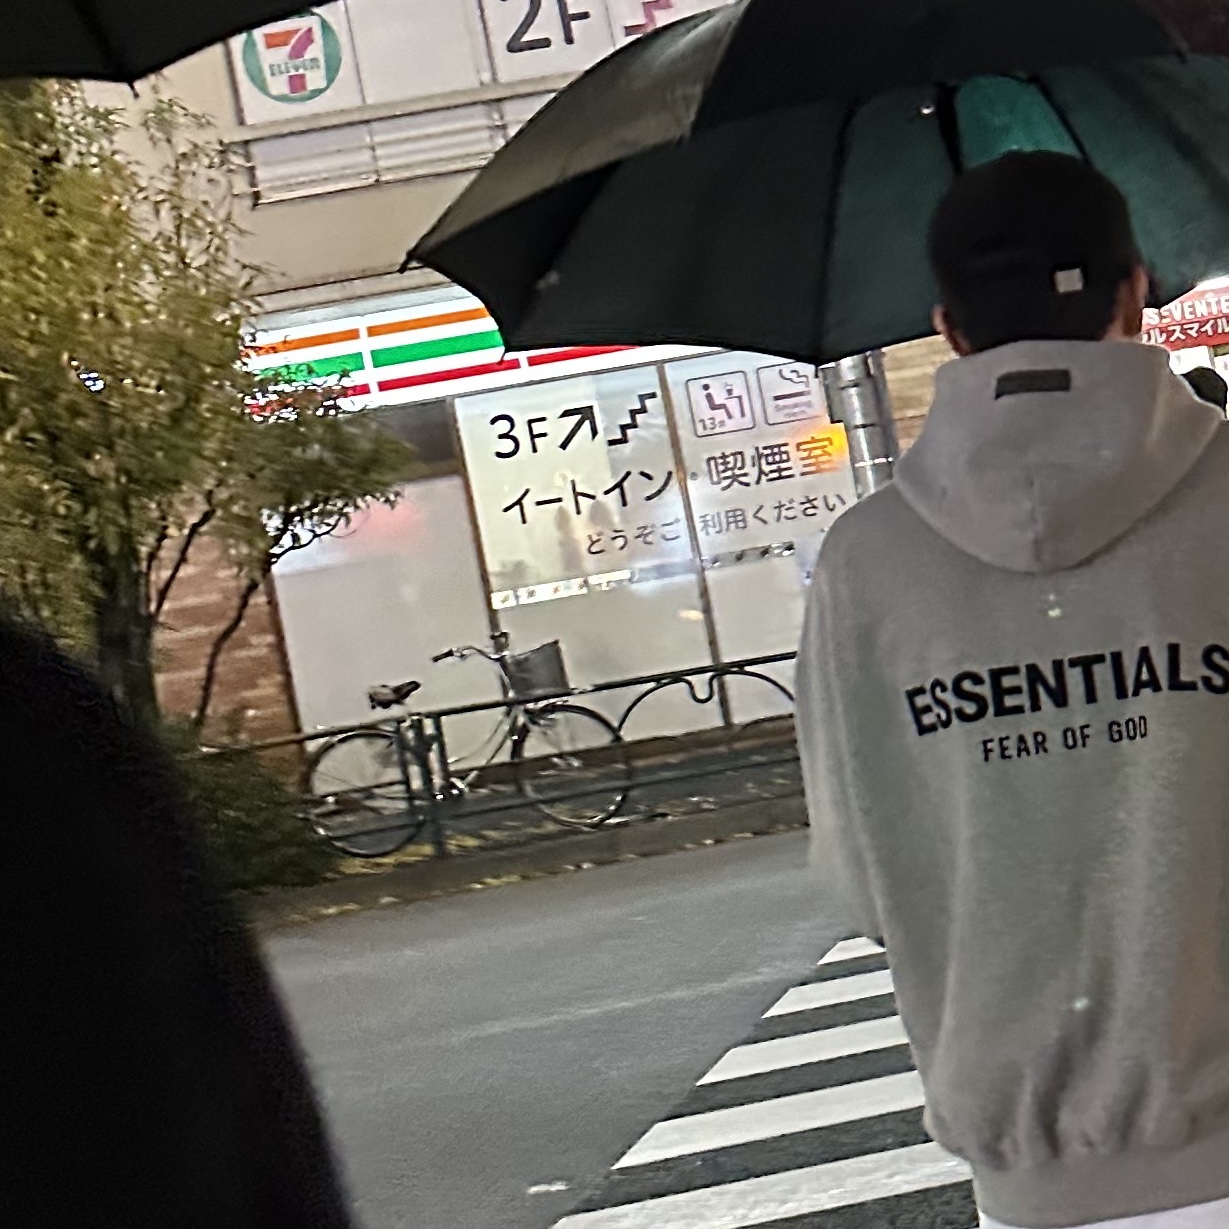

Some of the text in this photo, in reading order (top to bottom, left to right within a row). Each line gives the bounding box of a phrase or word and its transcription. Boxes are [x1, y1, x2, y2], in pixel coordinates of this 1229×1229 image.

[506, 0, 591, 53] 2F
[489, 413, 549, 459] 3F
[982, 715, 1149, 763] FEAR OF GOD
